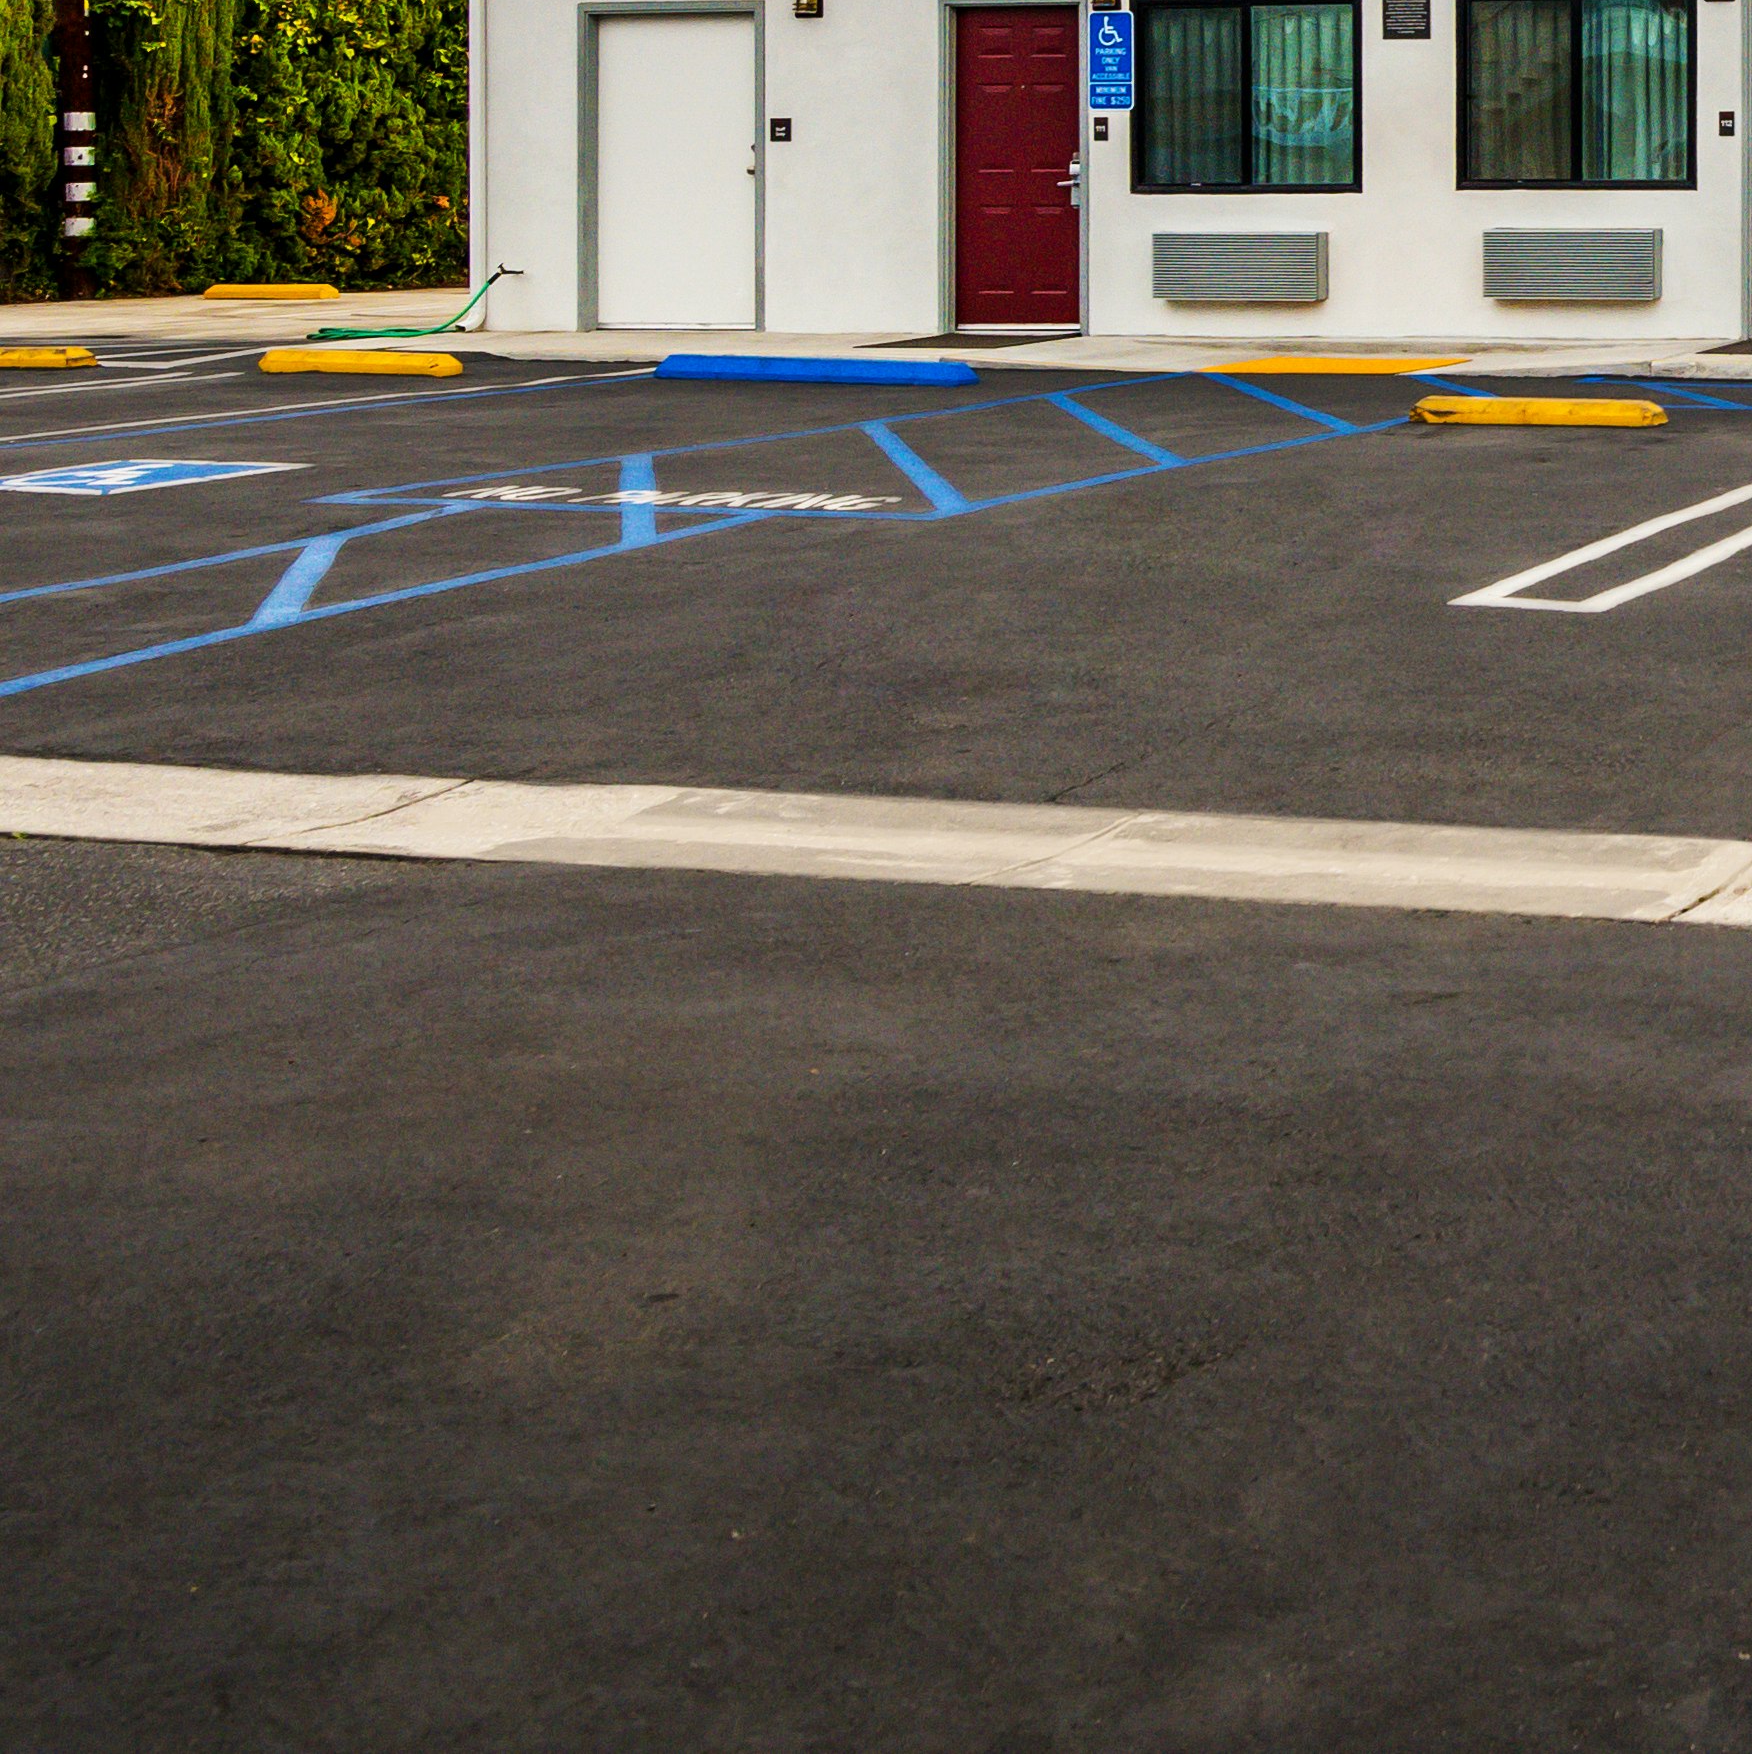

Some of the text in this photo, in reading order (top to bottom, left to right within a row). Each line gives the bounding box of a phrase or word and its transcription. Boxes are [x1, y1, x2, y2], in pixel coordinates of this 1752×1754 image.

[1095, 47, 1127, 56] PARKING
[1101, 56, 1121, 65] ONLY
[1092, 72, 1130, 80] ACCESSIBLE
[1095, 86, 1127, 94] MINIMUM
[1091, 96, 1131, 105] FINE $250
[442, 485, 902, 512] NO PARKING
